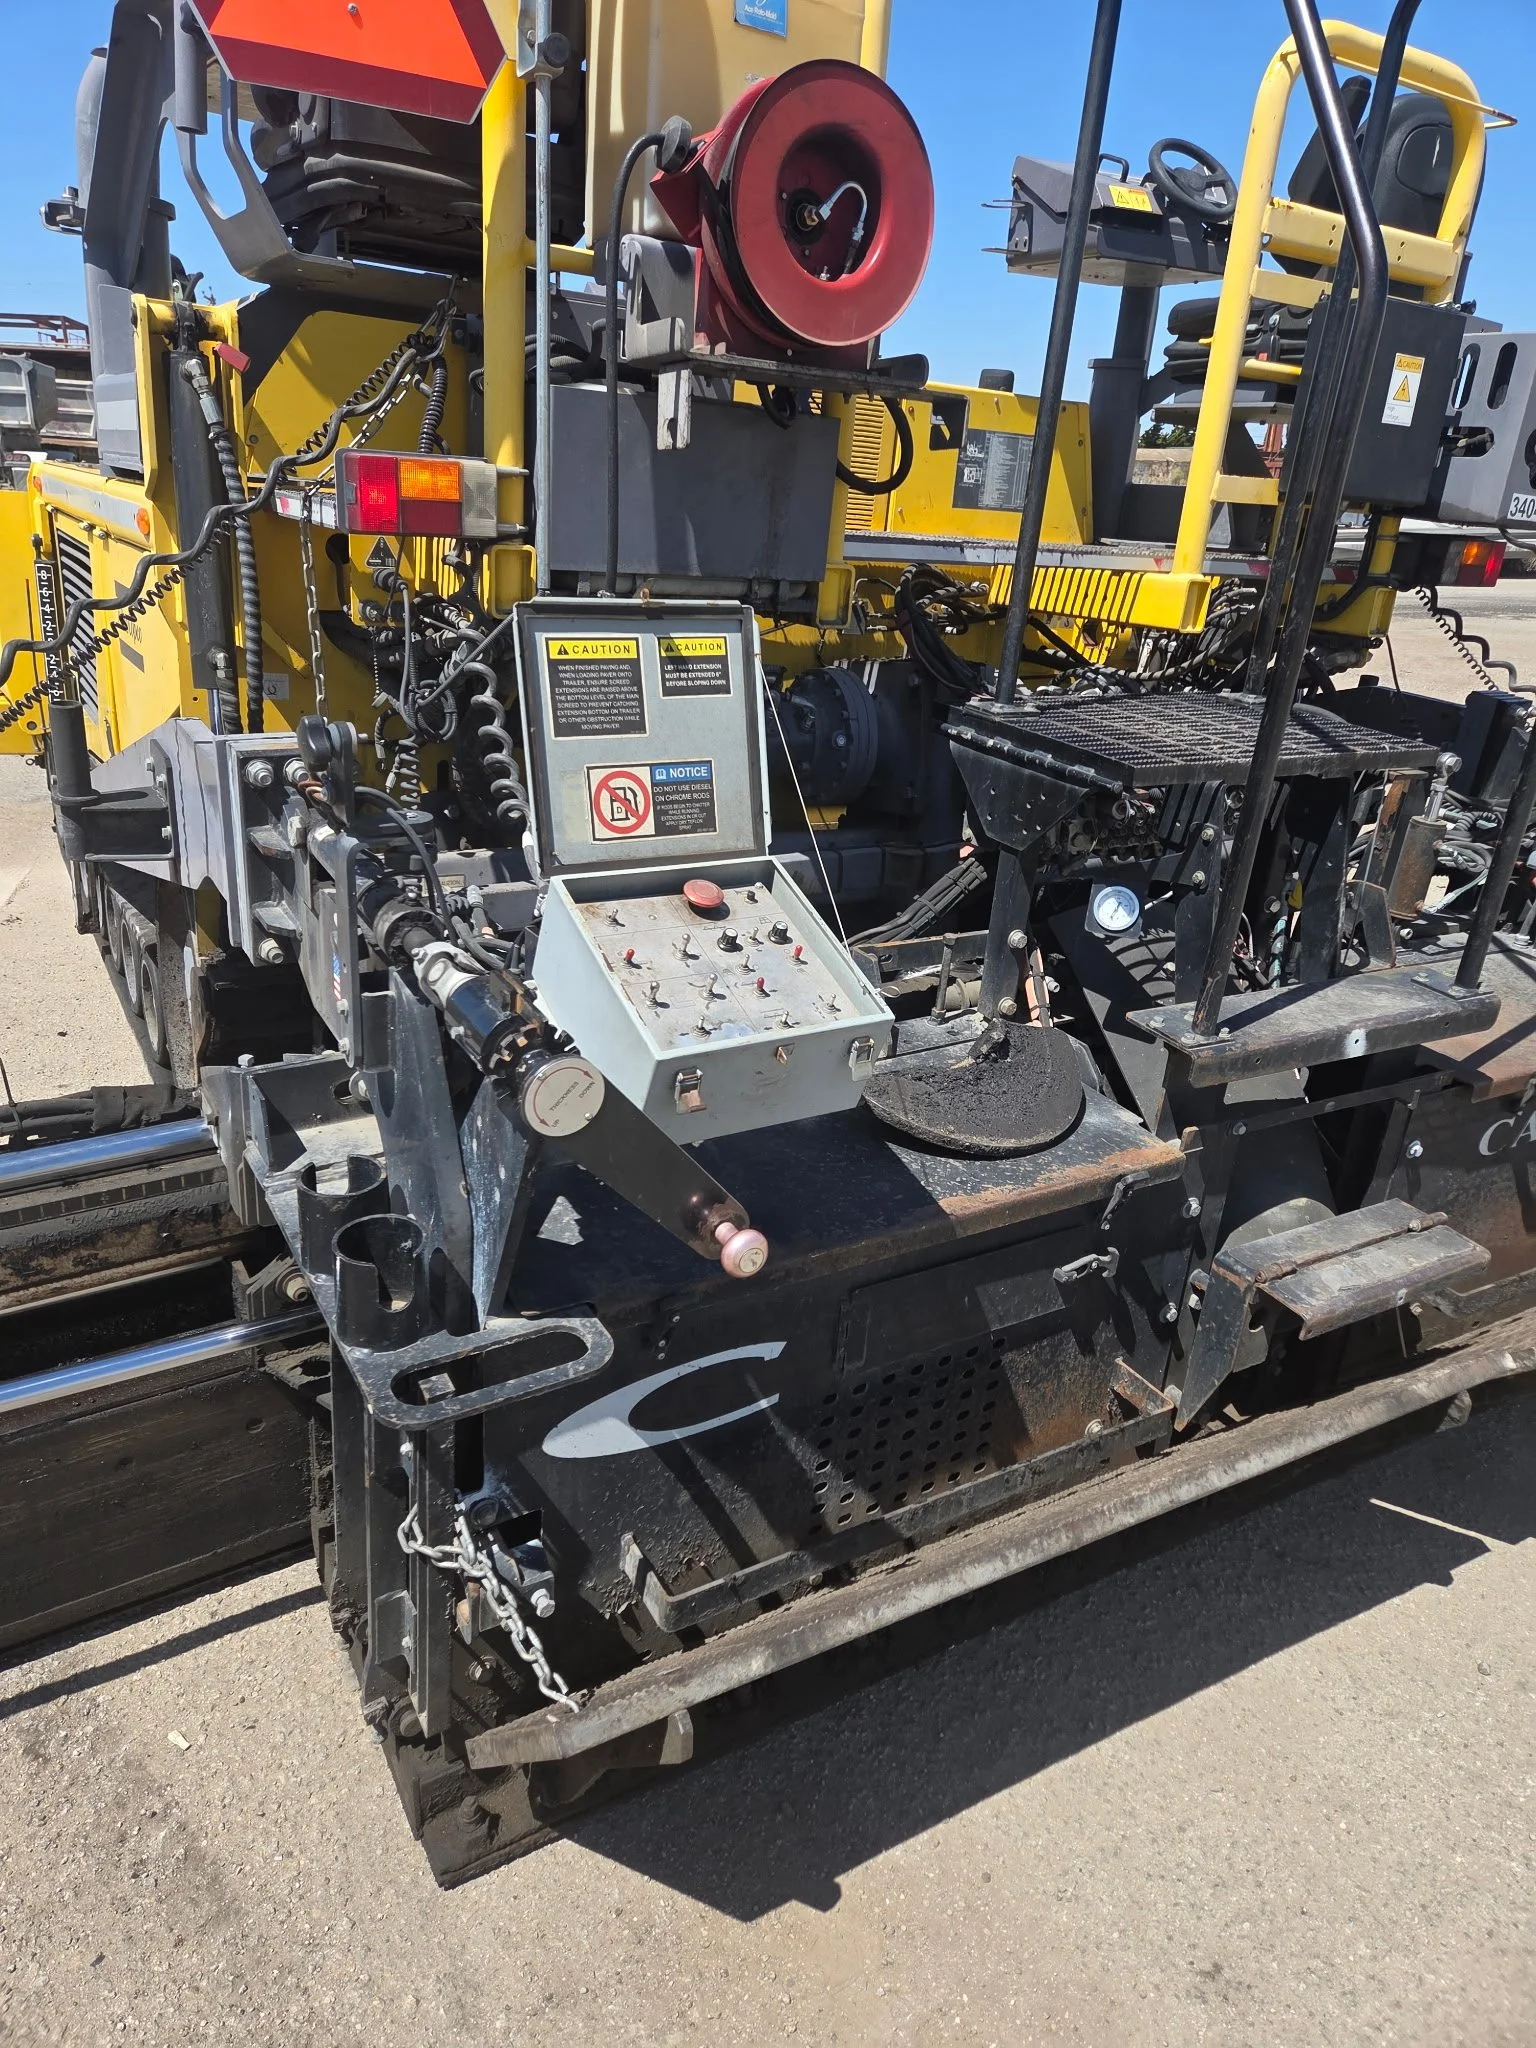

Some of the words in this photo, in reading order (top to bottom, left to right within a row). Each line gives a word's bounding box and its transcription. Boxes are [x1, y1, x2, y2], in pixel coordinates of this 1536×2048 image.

[1510, 496, 1536, 519] 340
[41, 570, 48, 580] 8
[42, 588, 50, 597] 6
[44, 604, 51, 614] 4
[46, 621, 52, 631] 2
[572, 644, 631, 654] CAUTION
[676, 643, 722, 651] CAUTION
[49, 654, 56, 664] 2
[669, 766, 708, 778] NOTICE
[578, 1081, 596, 1098] DOWN
[550, 1081, 580, 1112] THICKNESS
[552, 1118, 560, 1128] UP
